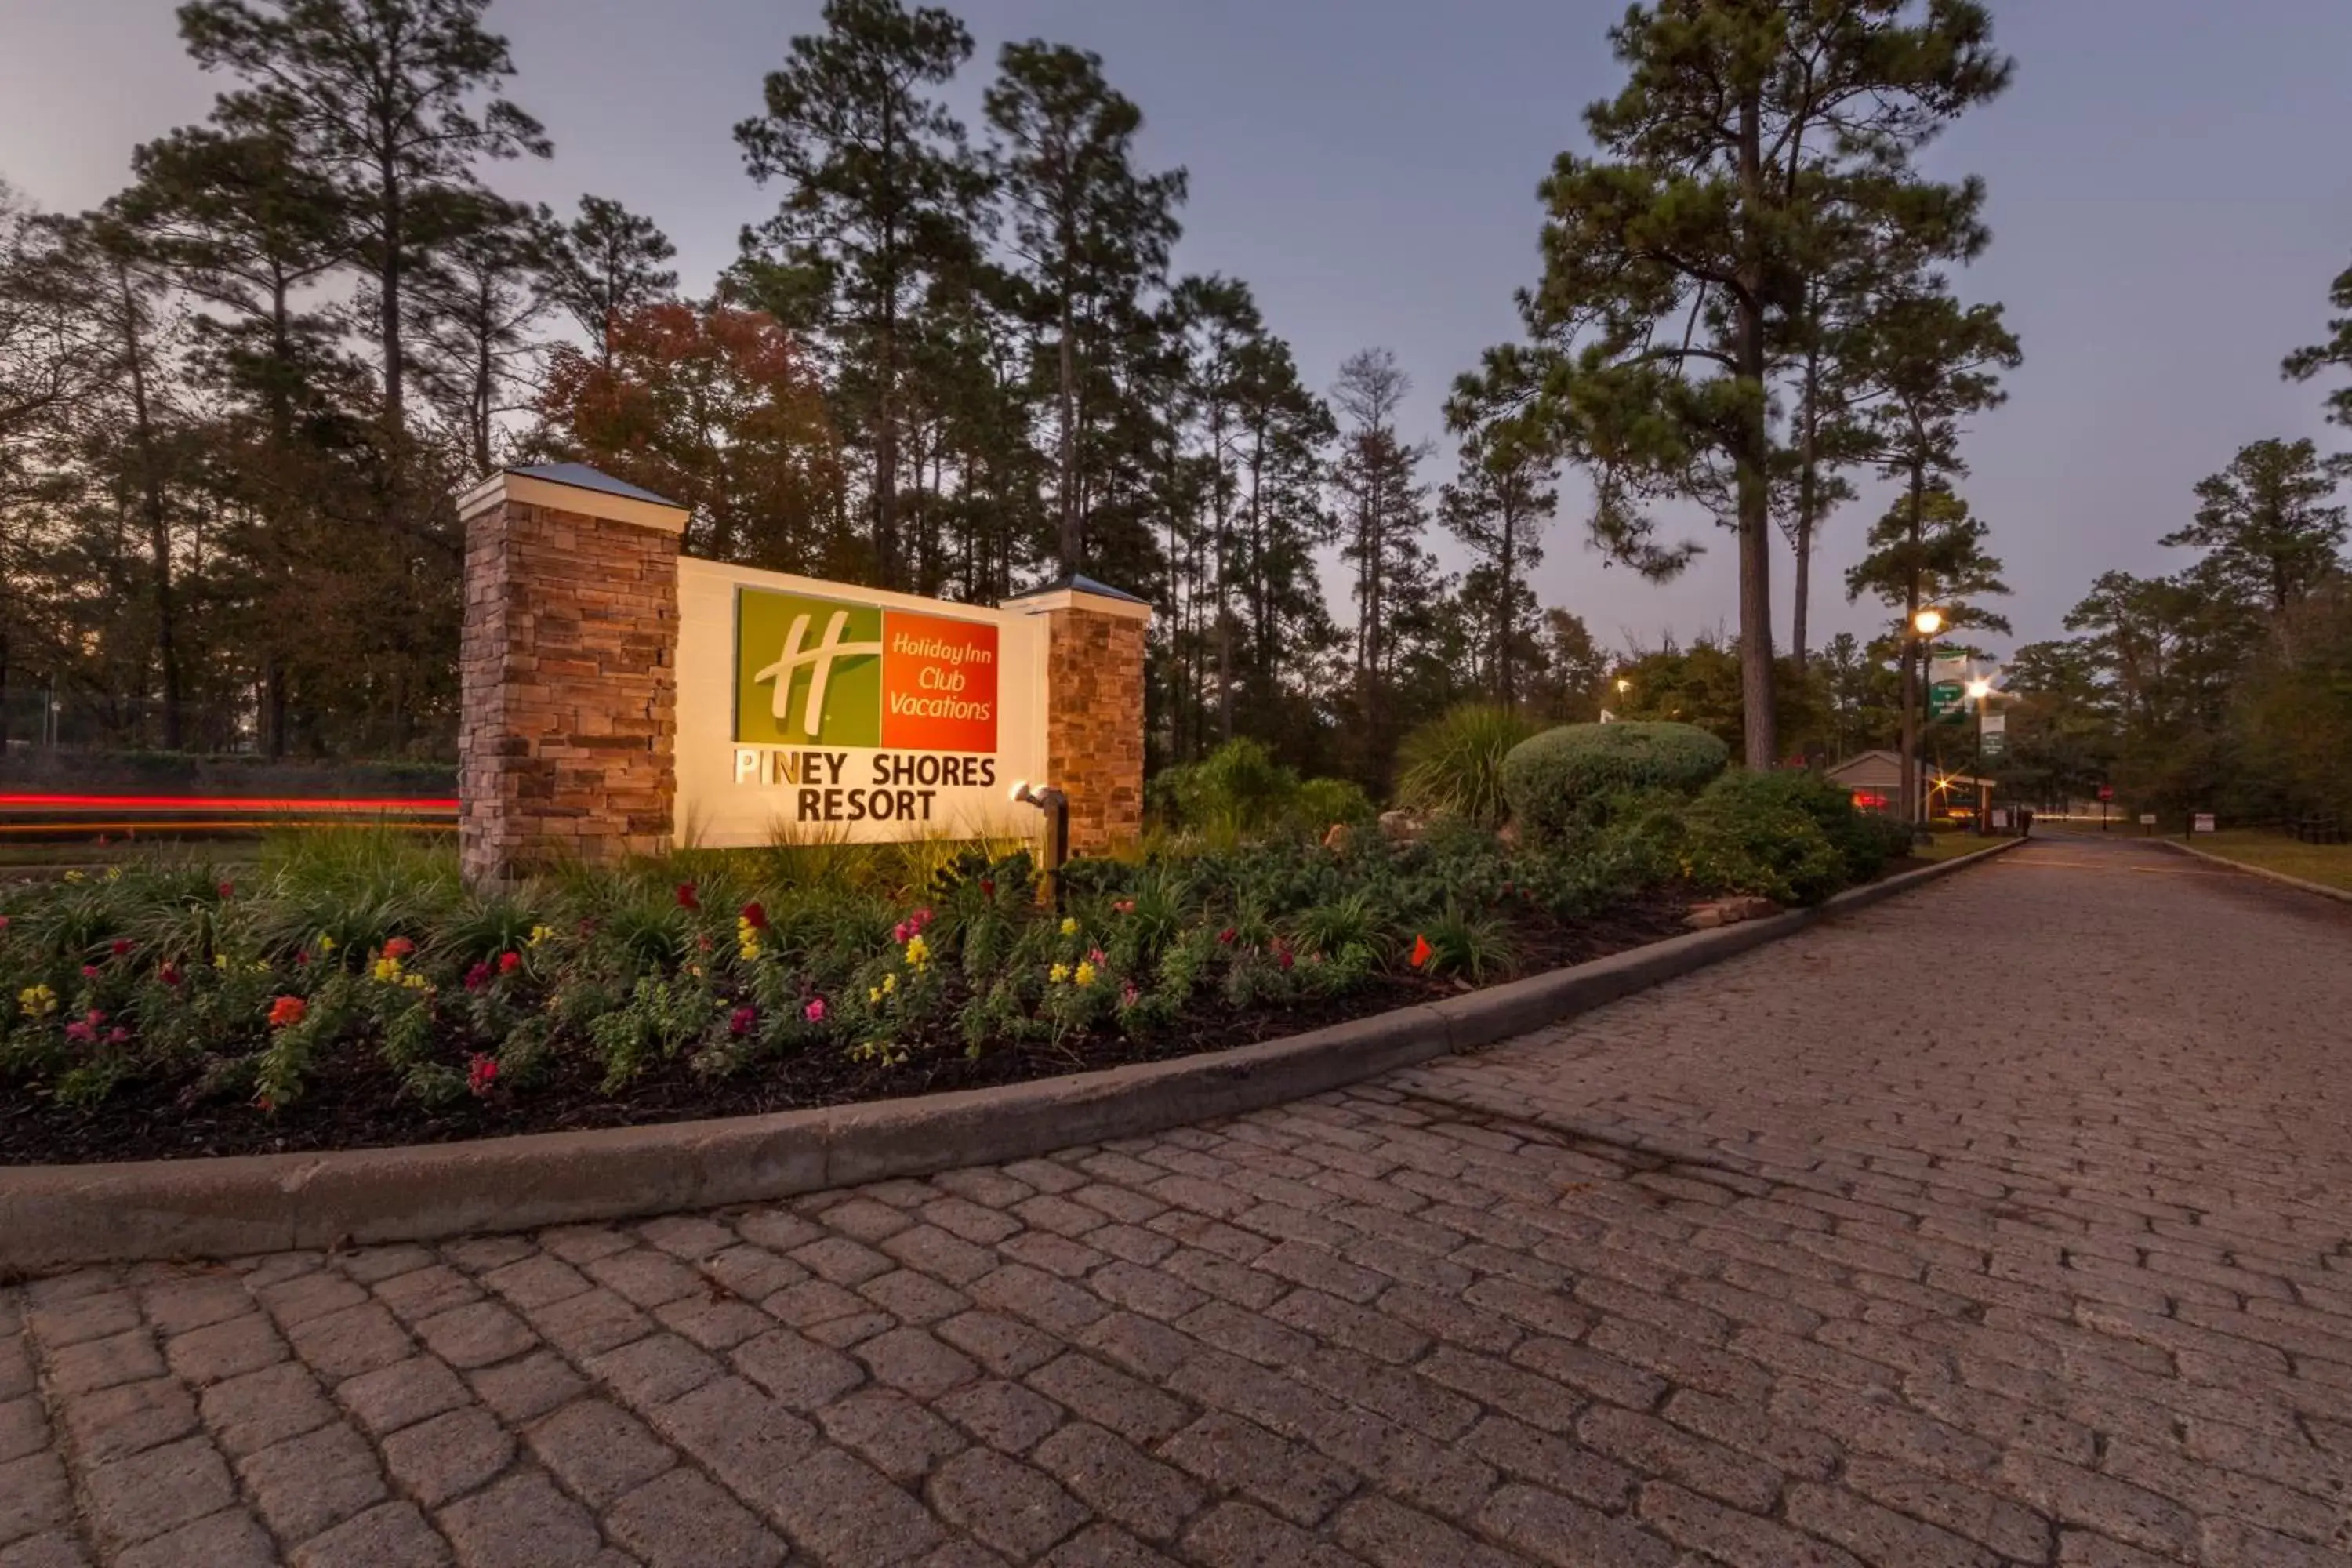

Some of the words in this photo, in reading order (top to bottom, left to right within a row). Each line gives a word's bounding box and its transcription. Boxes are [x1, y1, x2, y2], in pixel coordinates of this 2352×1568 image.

[892, 632, 964, 666] Holiday
[965, 641, 992, 664] Inn
[918, 666, 966, 691] Club
[891, 690, 992, 720] Vacations
[733, 749, 848, 785] PINEY
[872, 753, 996, 787] SHORES
[797, 788, 937, 822] RESORT
